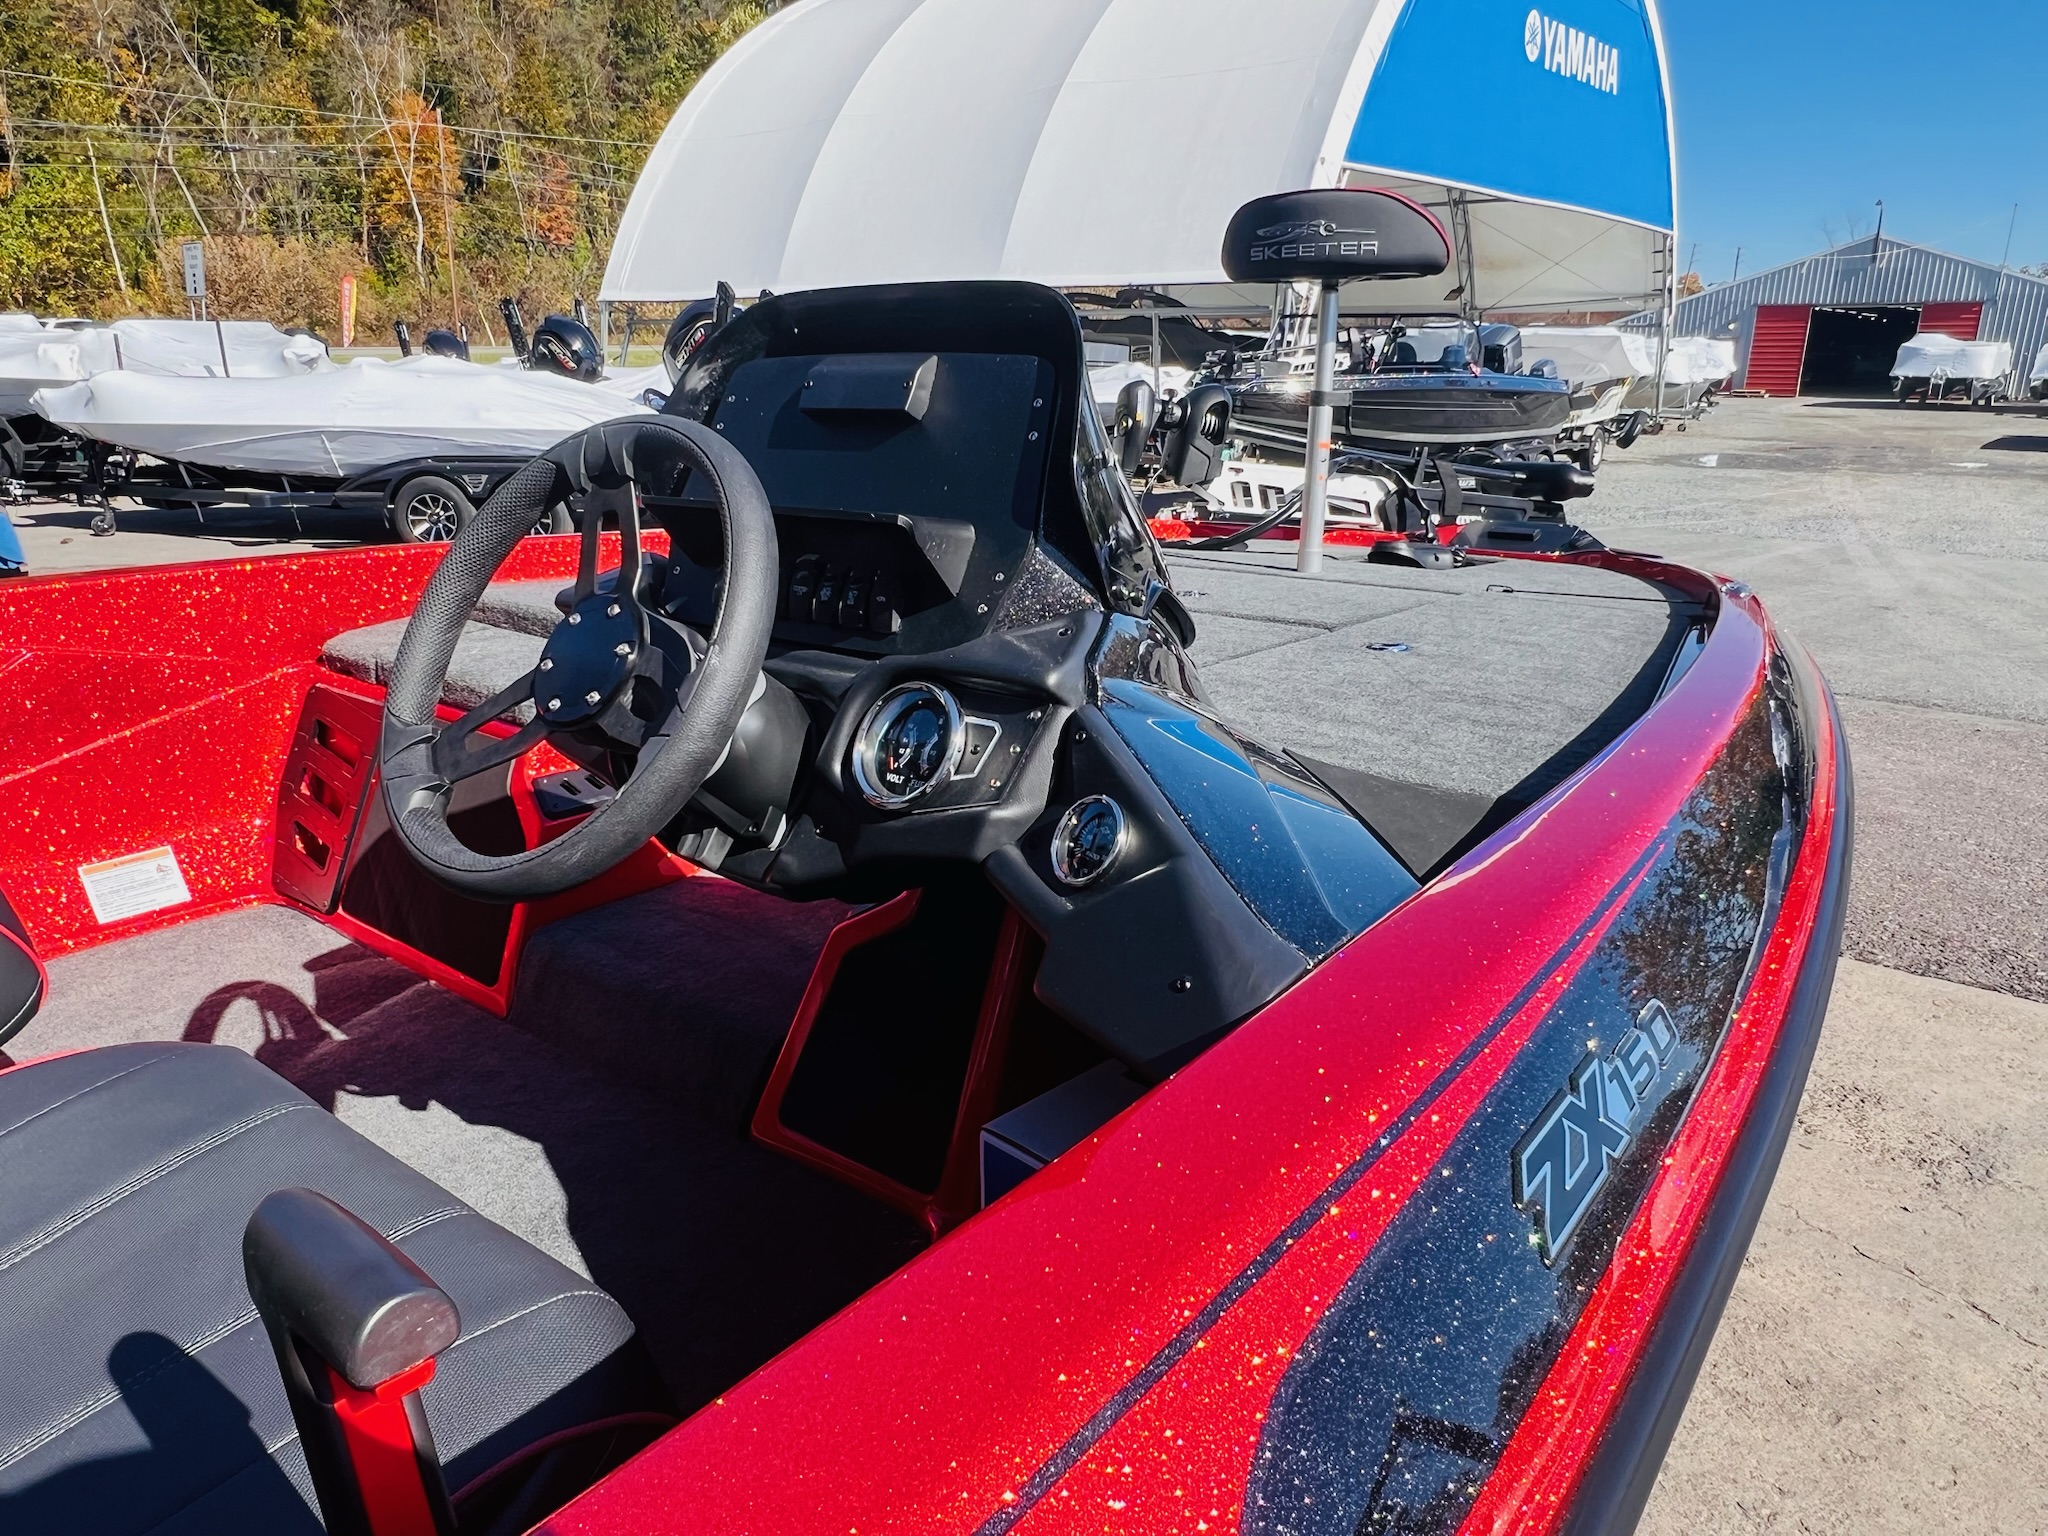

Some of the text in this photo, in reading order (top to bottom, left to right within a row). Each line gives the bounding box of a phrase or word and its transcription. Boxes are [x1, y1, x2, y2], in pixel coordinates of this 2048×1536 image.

[1543, 15, 1619, 96] YAMAHA
[1250, 240, 1379, 262] SKEETER
[886, 772, 905, 784] VOLT
